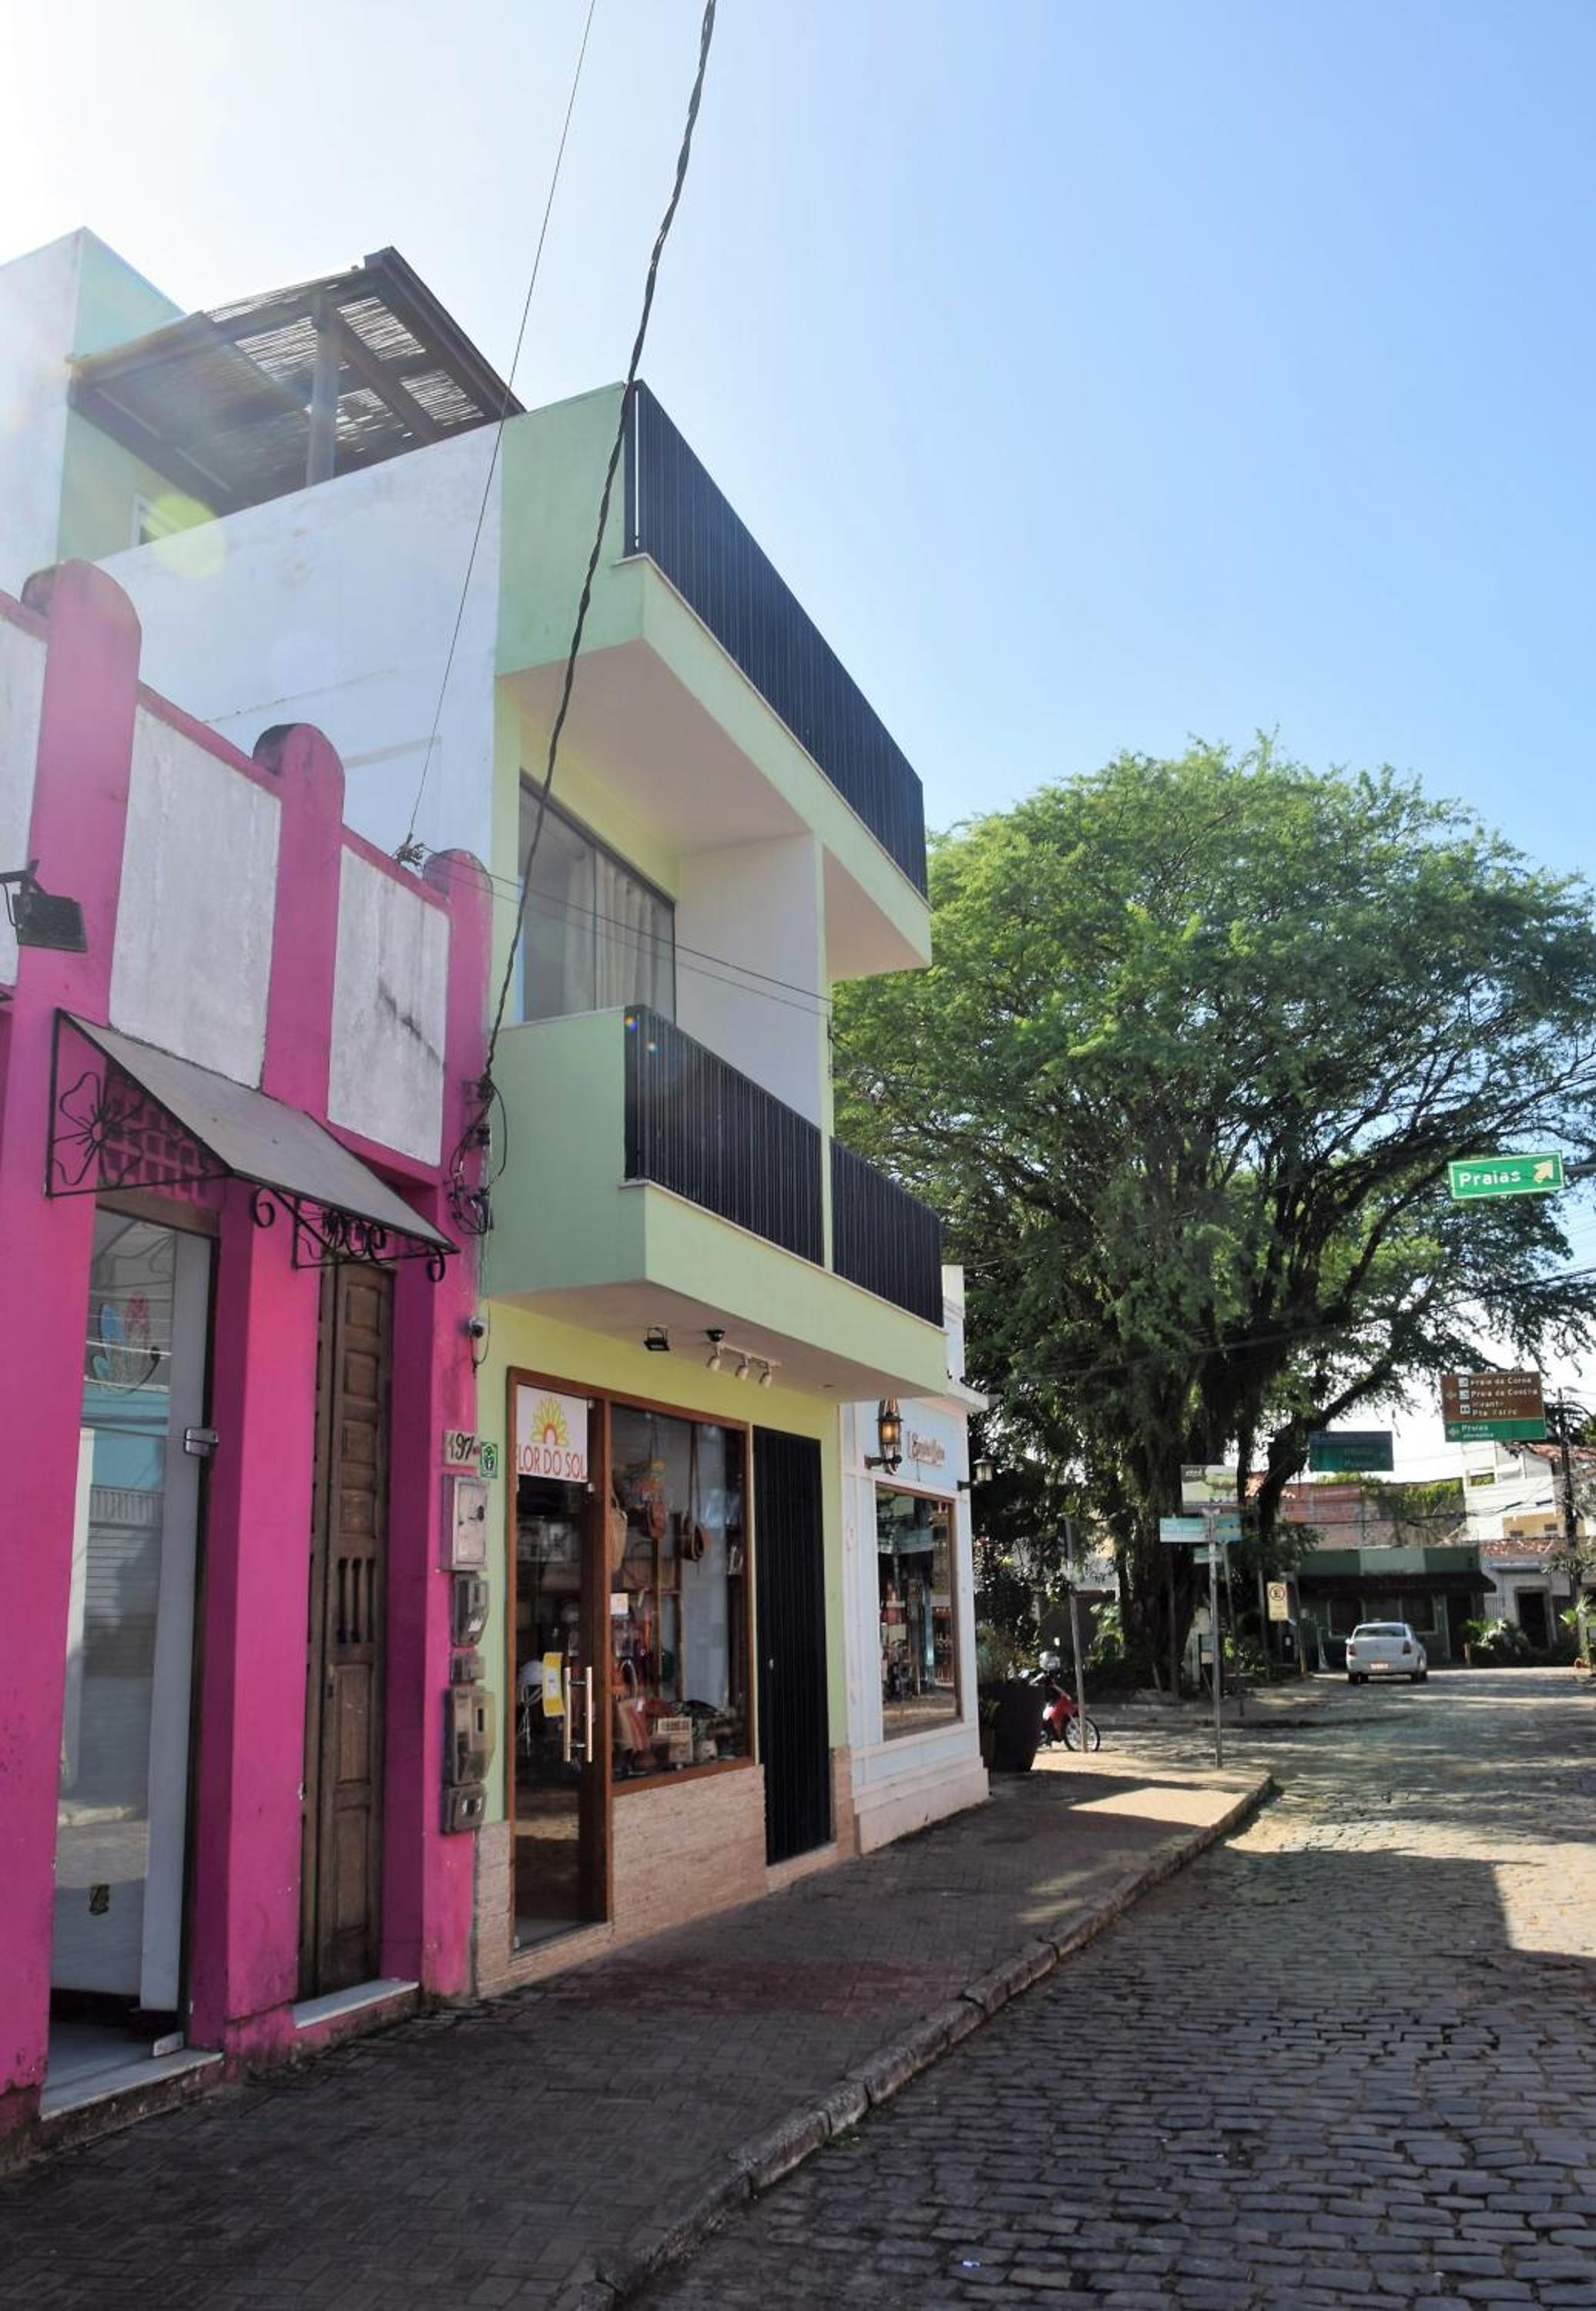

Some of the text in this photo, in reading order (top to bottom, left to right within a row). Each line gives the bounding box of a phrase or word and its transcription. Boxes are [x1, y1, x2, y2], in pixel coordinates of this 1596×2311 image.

[1459, 1170, 1522, 1188] Praias
[517, 1443, 588, 1481] LOR DO SOL
